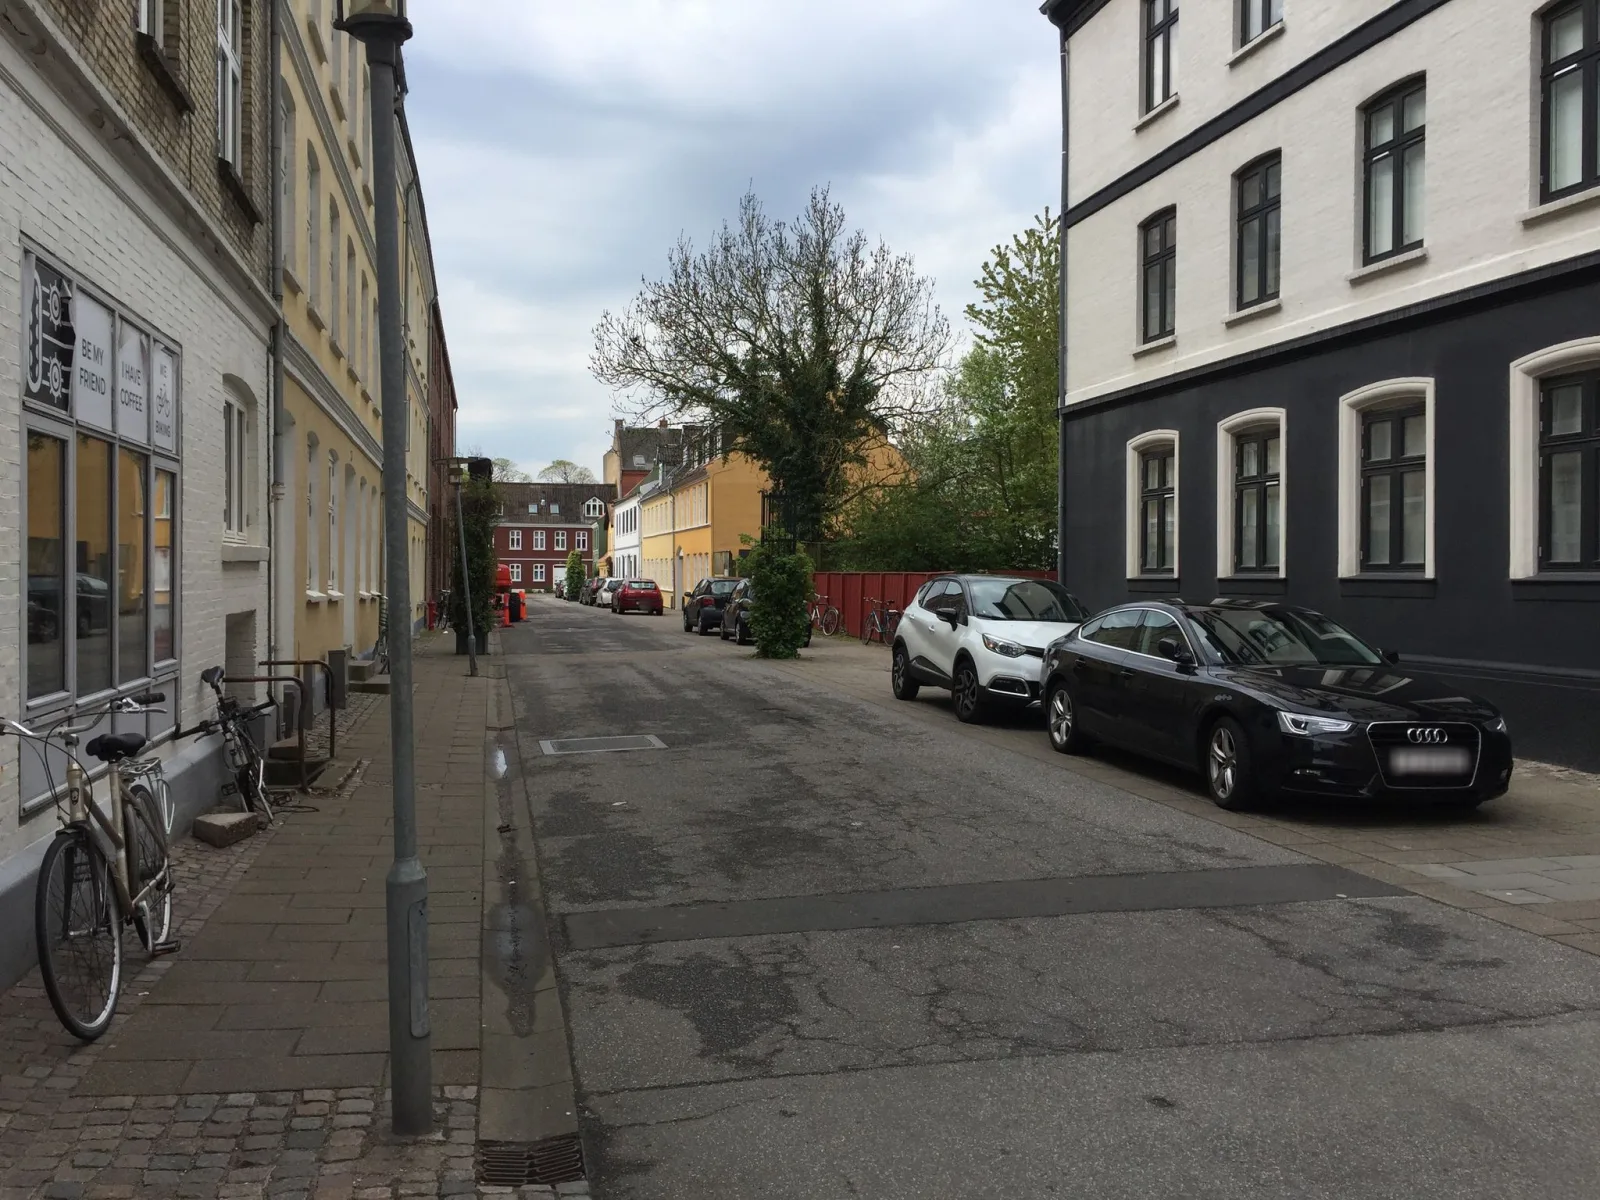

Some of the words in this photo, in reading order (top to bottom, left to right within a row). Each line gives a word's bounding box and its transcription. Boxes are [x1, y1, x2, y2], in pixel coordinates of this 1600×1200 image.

[82, 338, 92, 360] BE
[93, 345, 104, 366] MY
[80, 366, 106, 395] FRIEND
[125, 363, 141, 386] HAVE
[120, 388, 142, 412] COFFEE
